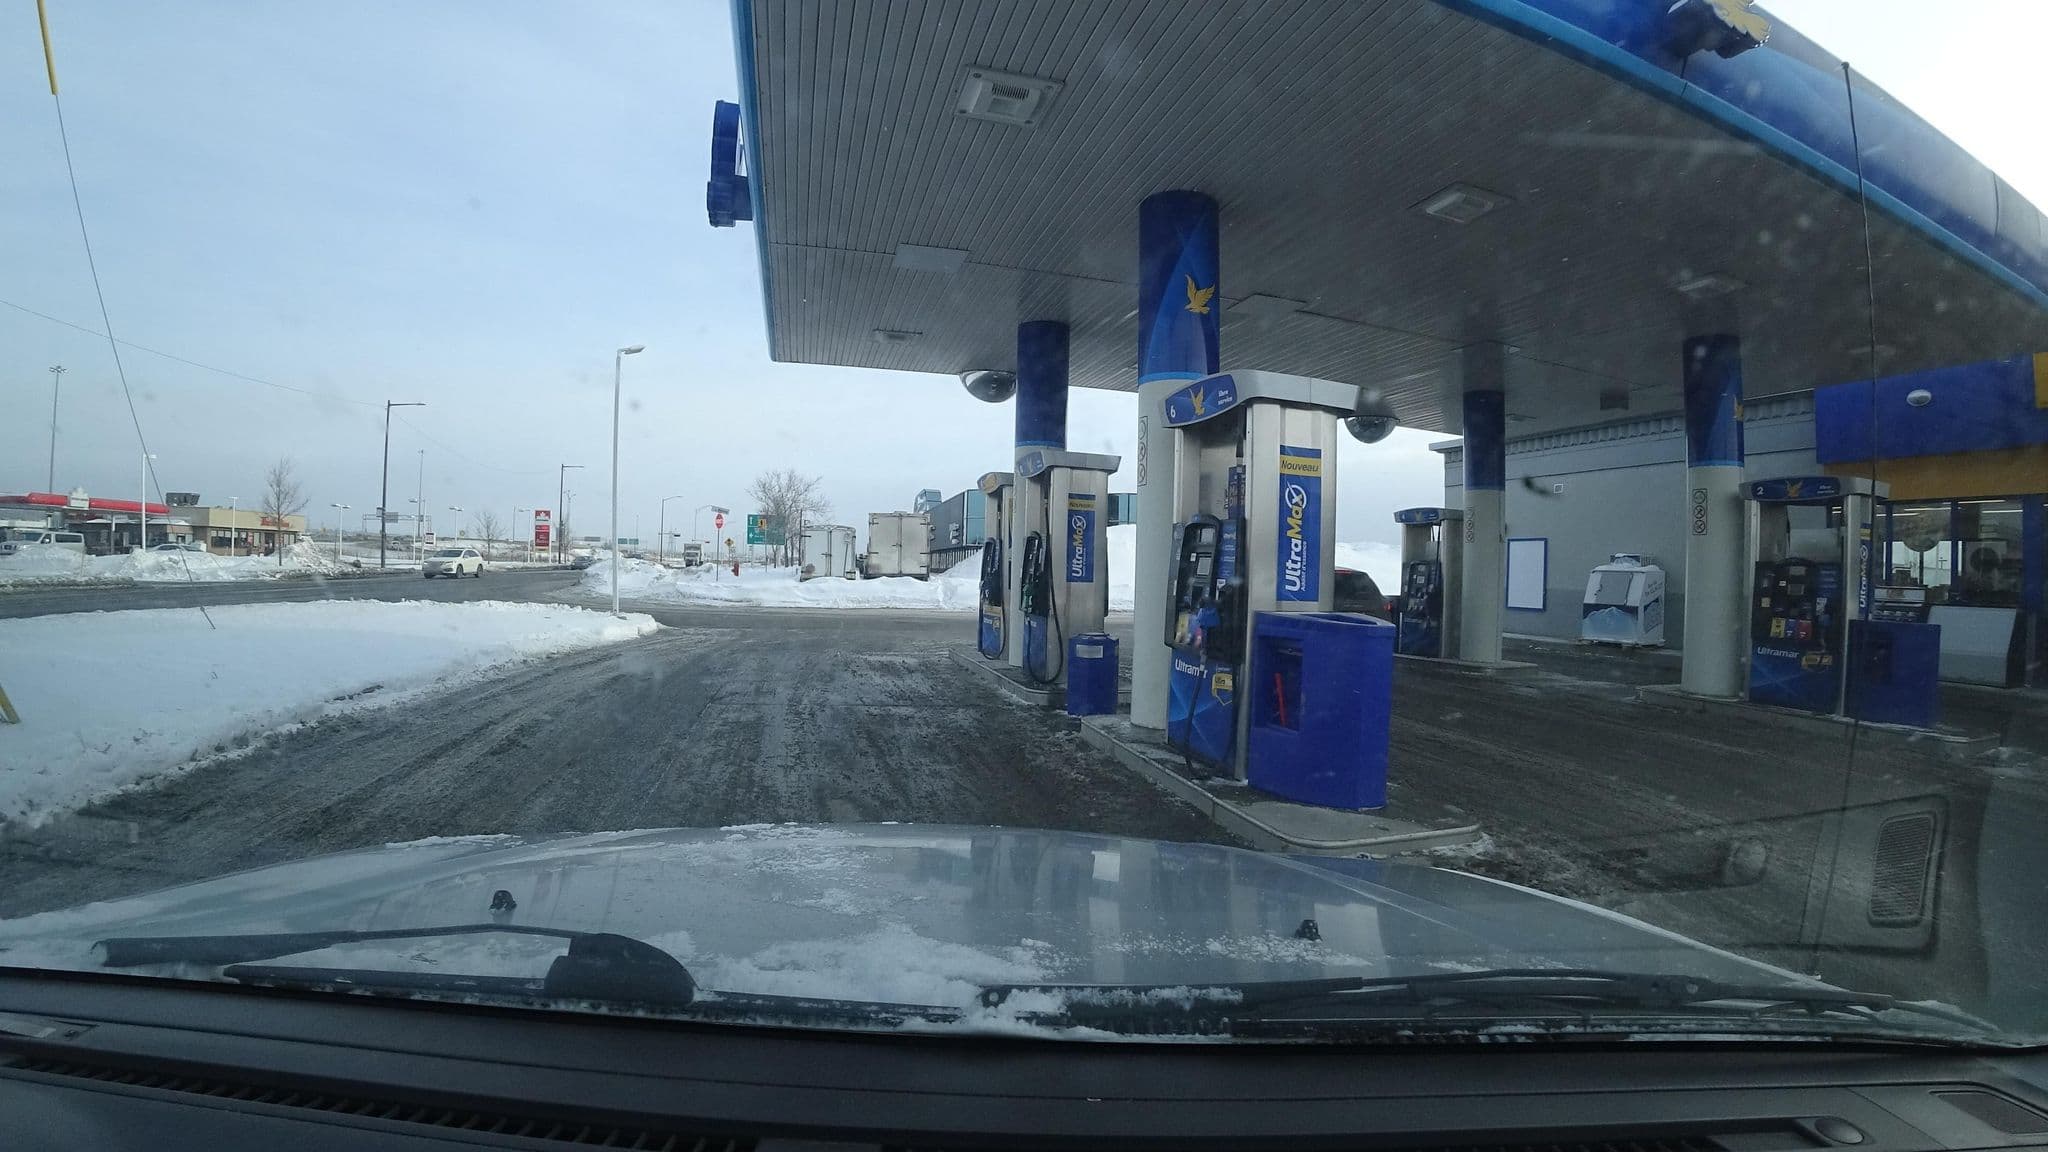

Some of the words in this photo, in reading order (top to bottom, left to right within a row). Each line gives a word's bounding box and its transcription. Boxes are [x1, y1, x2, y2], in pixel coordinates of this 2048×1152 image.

[1170, 405, 1177, 418] 6
[1281, 460, 1319, 472] Nouveau
[1756, 486, 1764, 496] 2
[1285, 480, 1307, 592] UltraMax
[1071, 515, 1087, 577] UltraMax
[1757, 646, 1800, 659] Ultramar
[1174, 658, 1208, 679] Ultramr
